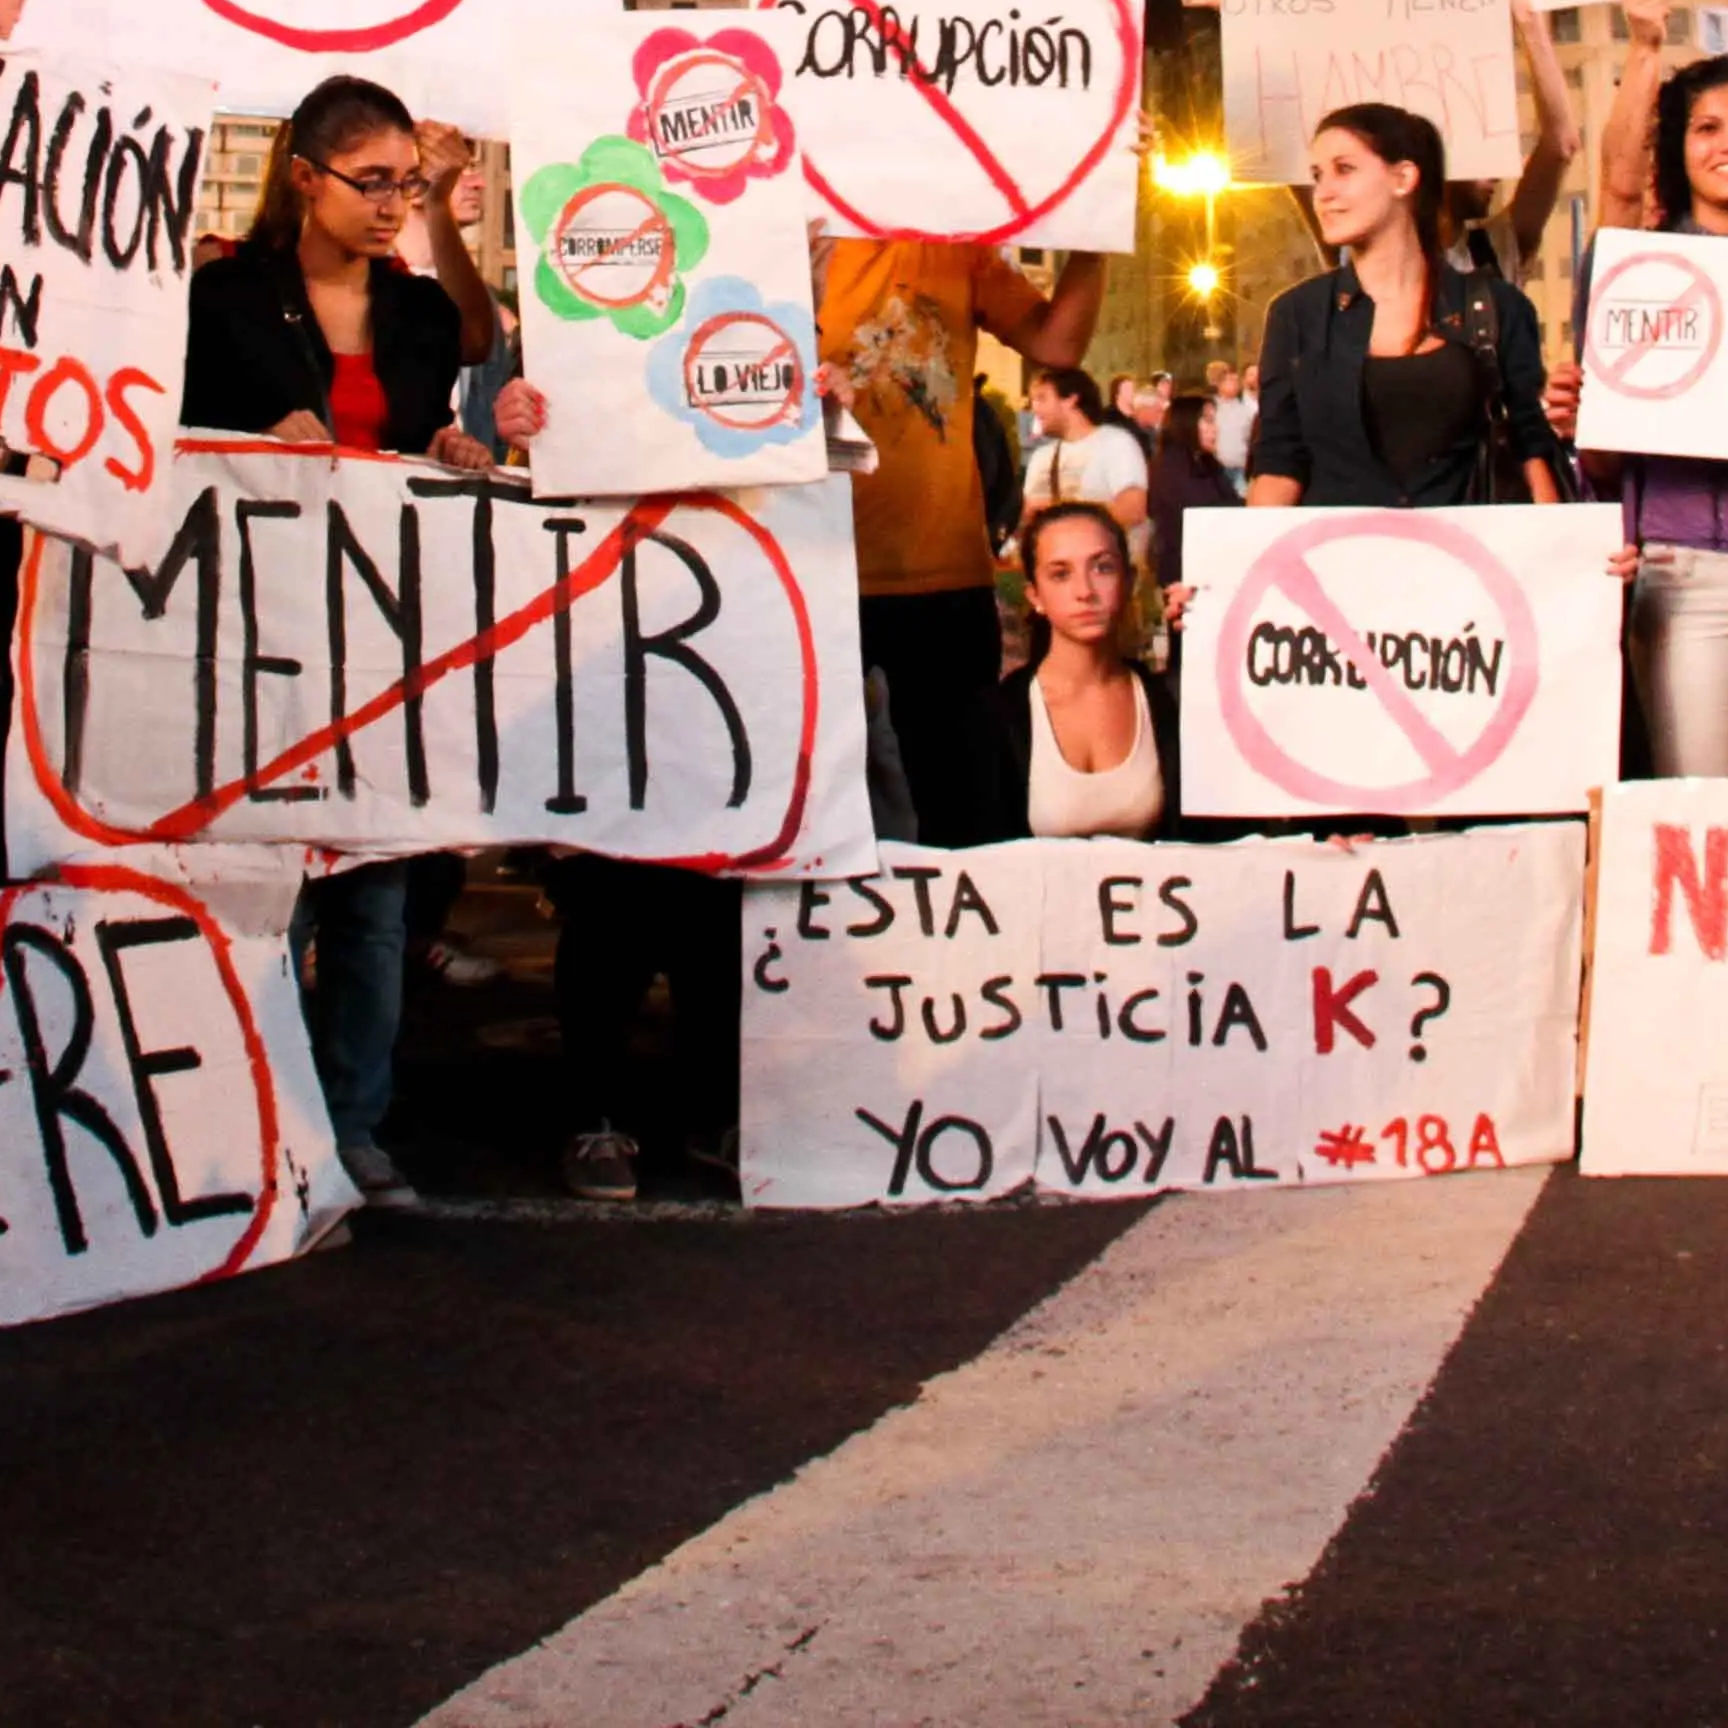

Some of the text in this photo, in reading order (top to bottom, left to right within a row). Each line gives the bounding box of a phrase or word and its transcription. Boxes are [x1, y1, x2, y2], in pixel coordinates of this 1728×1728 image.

[659, 98, 757, 146] MENTIR
[1603, 306, 1699, 345] MENTIR
[696, 358, 795, 396] LO VIEJO
[62, 478, 754, 816] MENTIR
[1097, 874, 1200, 947] ES
[1283, 869, 1401, 943] LA
[865, 971, 1269, 1052] JUSTICIA
[854, 1098, 1508, 1196] YO VOY AL #18A
